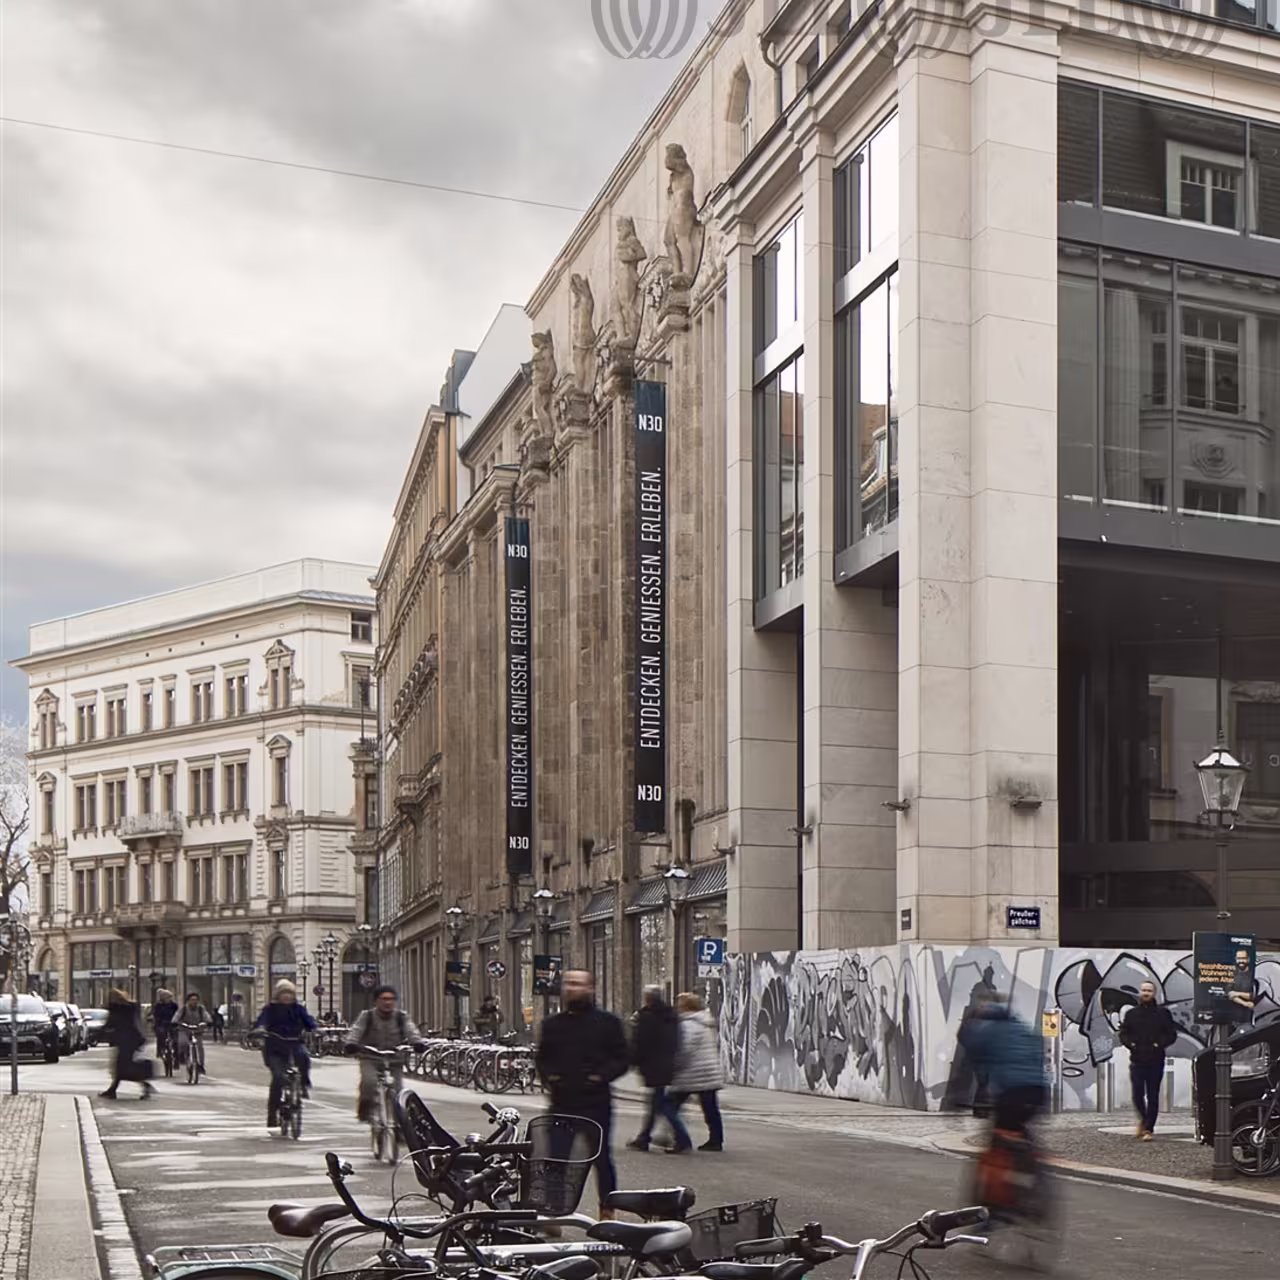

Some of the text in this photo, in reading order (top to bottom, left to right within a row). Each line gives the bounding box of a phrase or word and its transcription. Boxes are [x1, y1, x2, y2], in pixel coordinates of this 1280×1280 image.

[511, 585, 528, 808] ENTDECKEN. GENIESSEN. ERLEBEN.
[640, 466, 661, 748] ENTDECKEN. GENIESSEN. ERLEBEN.
